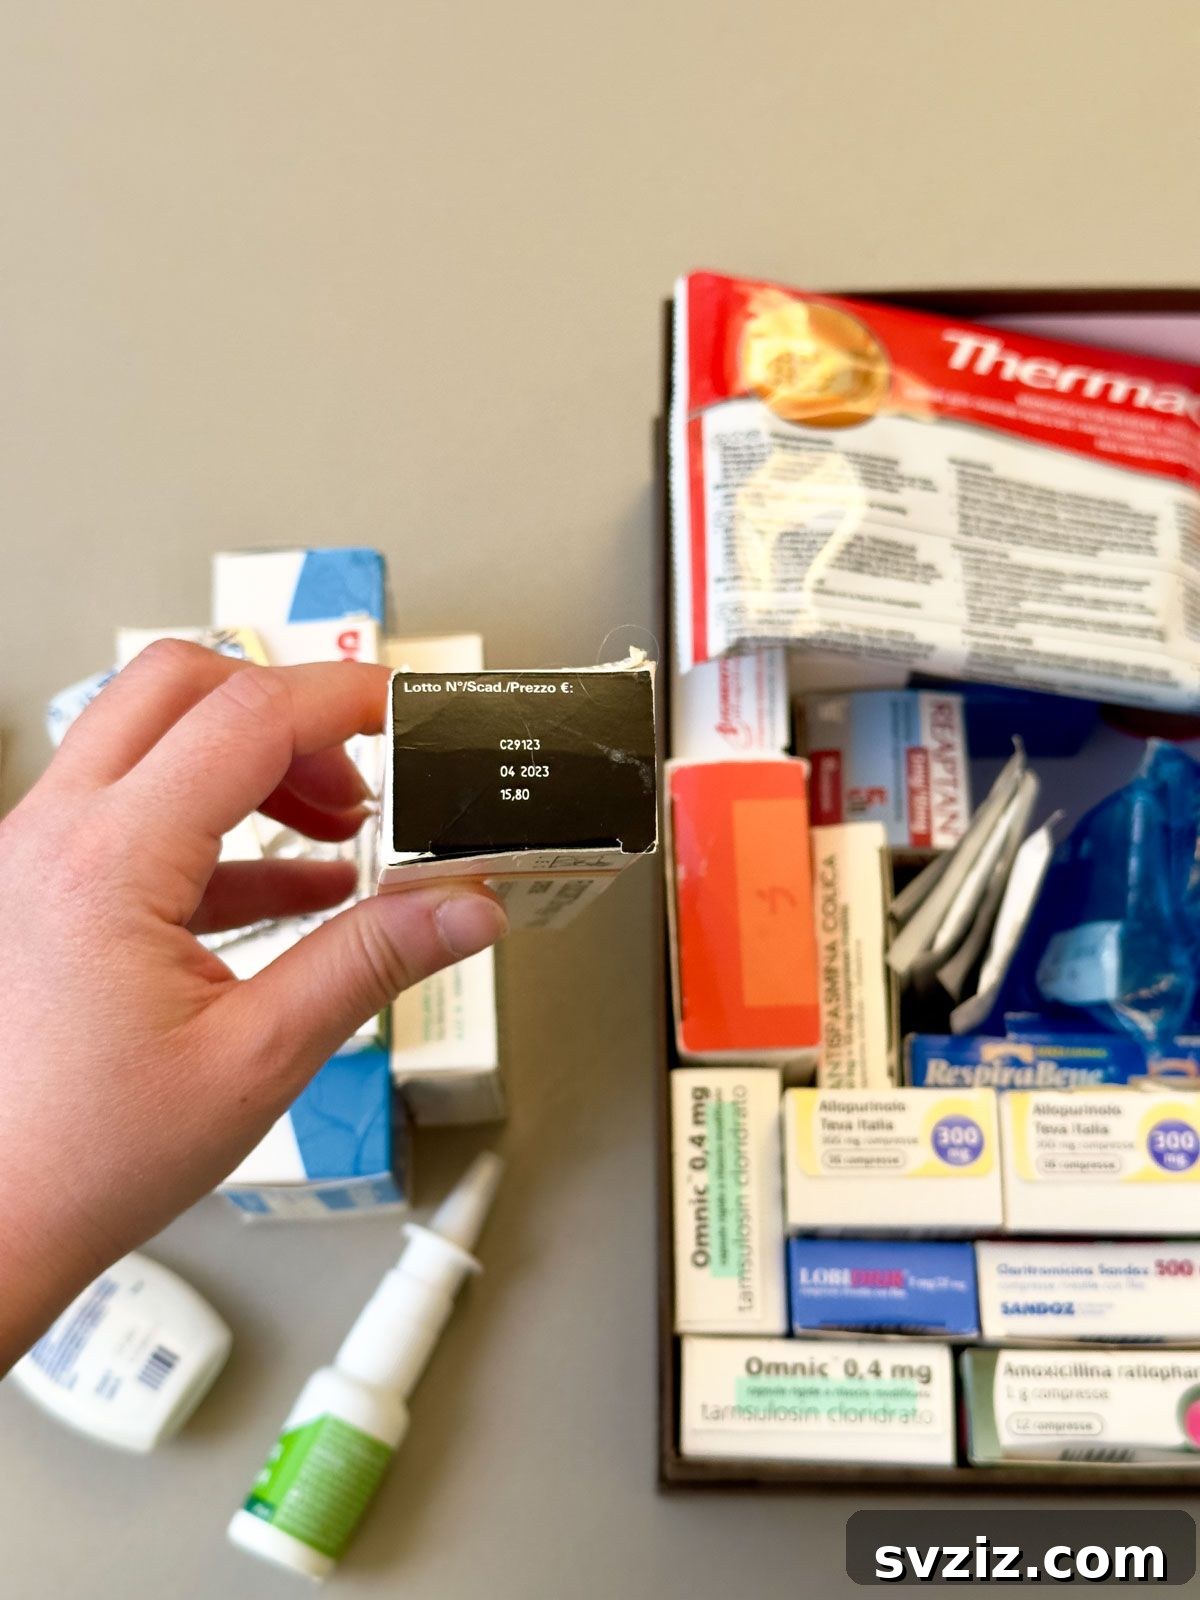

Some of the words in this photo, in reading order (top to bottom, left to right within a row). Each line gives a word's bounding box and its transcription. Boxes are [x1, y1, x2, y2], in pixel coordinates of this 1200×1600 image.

[941, 327, 1200, 424] Therma
[404, 682, 442, 693] Lotto
[561, 682, 574, 694] €:
[500, 739, 541, 751] C29123
[500, 765, 516, 778] 04
[521, 766, 550, 778] 2023
[500, 788, 530, 801] 15,80
[820, 854, 838, 934] COLICA
[691, 1087, 711, 1125] mg
[937, 1125, 979, 1146] 300
[1152, 1130, 1196, 1150] 300
[689, 1135, 710, 1173] 0,4
[691, 1184, 711, 1270] Omnic
[1154, 1258, 1194, 1277] 500
[1001, 1301, 1075, 1316] SANDOZ
[745, 1356, 828, 1377] Omnic
[843, 1357, 882, 1380] 0,4
[890, 1362, 932, 1384] mg
